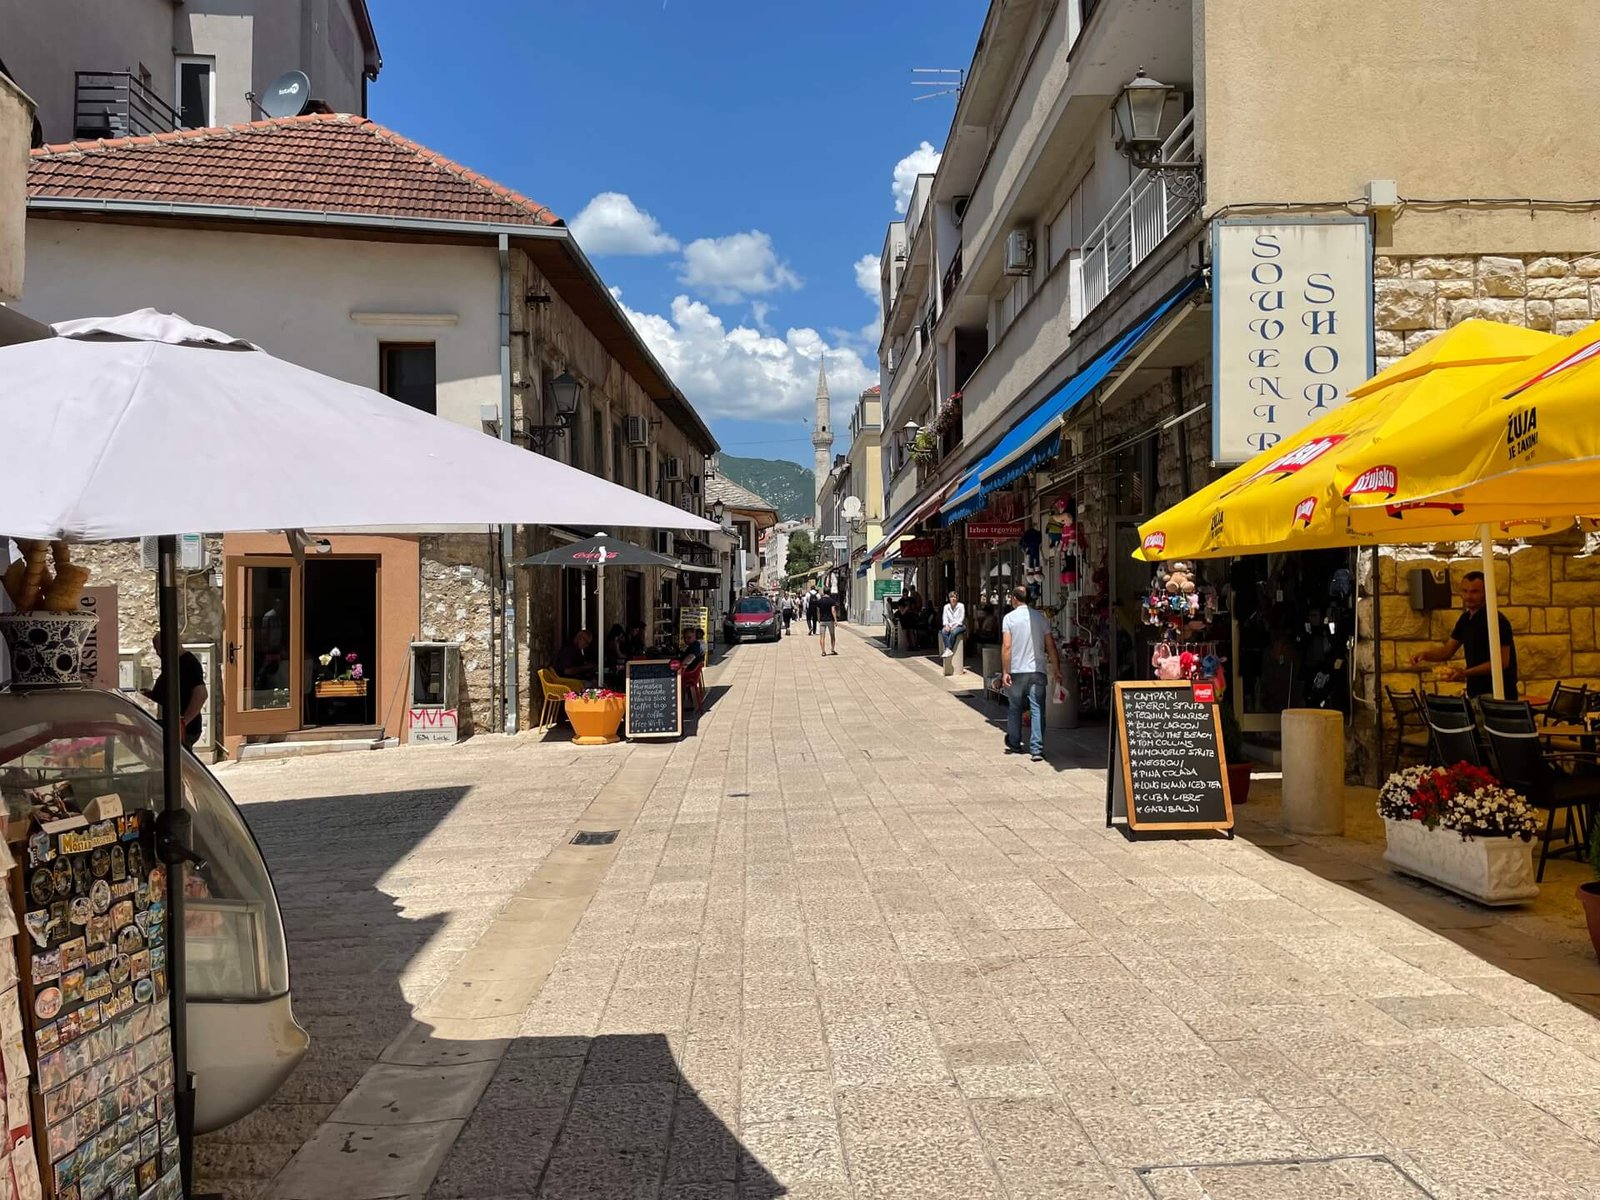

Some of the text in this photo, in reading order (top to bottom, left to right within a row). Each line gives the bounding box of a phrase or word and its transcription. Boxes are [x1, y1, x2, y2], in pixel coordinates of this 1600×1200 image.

[1246, 234, 1296, 452] SOUVENIR
[1301, 273, 1339, 417] SHOP
[1506, 406, 1537, 445] ŽUJA
[1133, 691, 1178, 701] CAMPARI
[1135, 701, 1171, 711] APEROL
[1136, 720, 1200, 730] BLUE LAGOON
[1166, 731, 1182, 739] THE
[1137, 739, 1194, 748] TOM COLLINS
[1138, 759, 1185, 768] NEGRONI
[1140, 779, 1222, 790] LONG ISLAND ICED TEA
[1142, 793, 1205, 803] CUBA LIBRE
[1144, 804, 1200, 814] GARIBALDI
